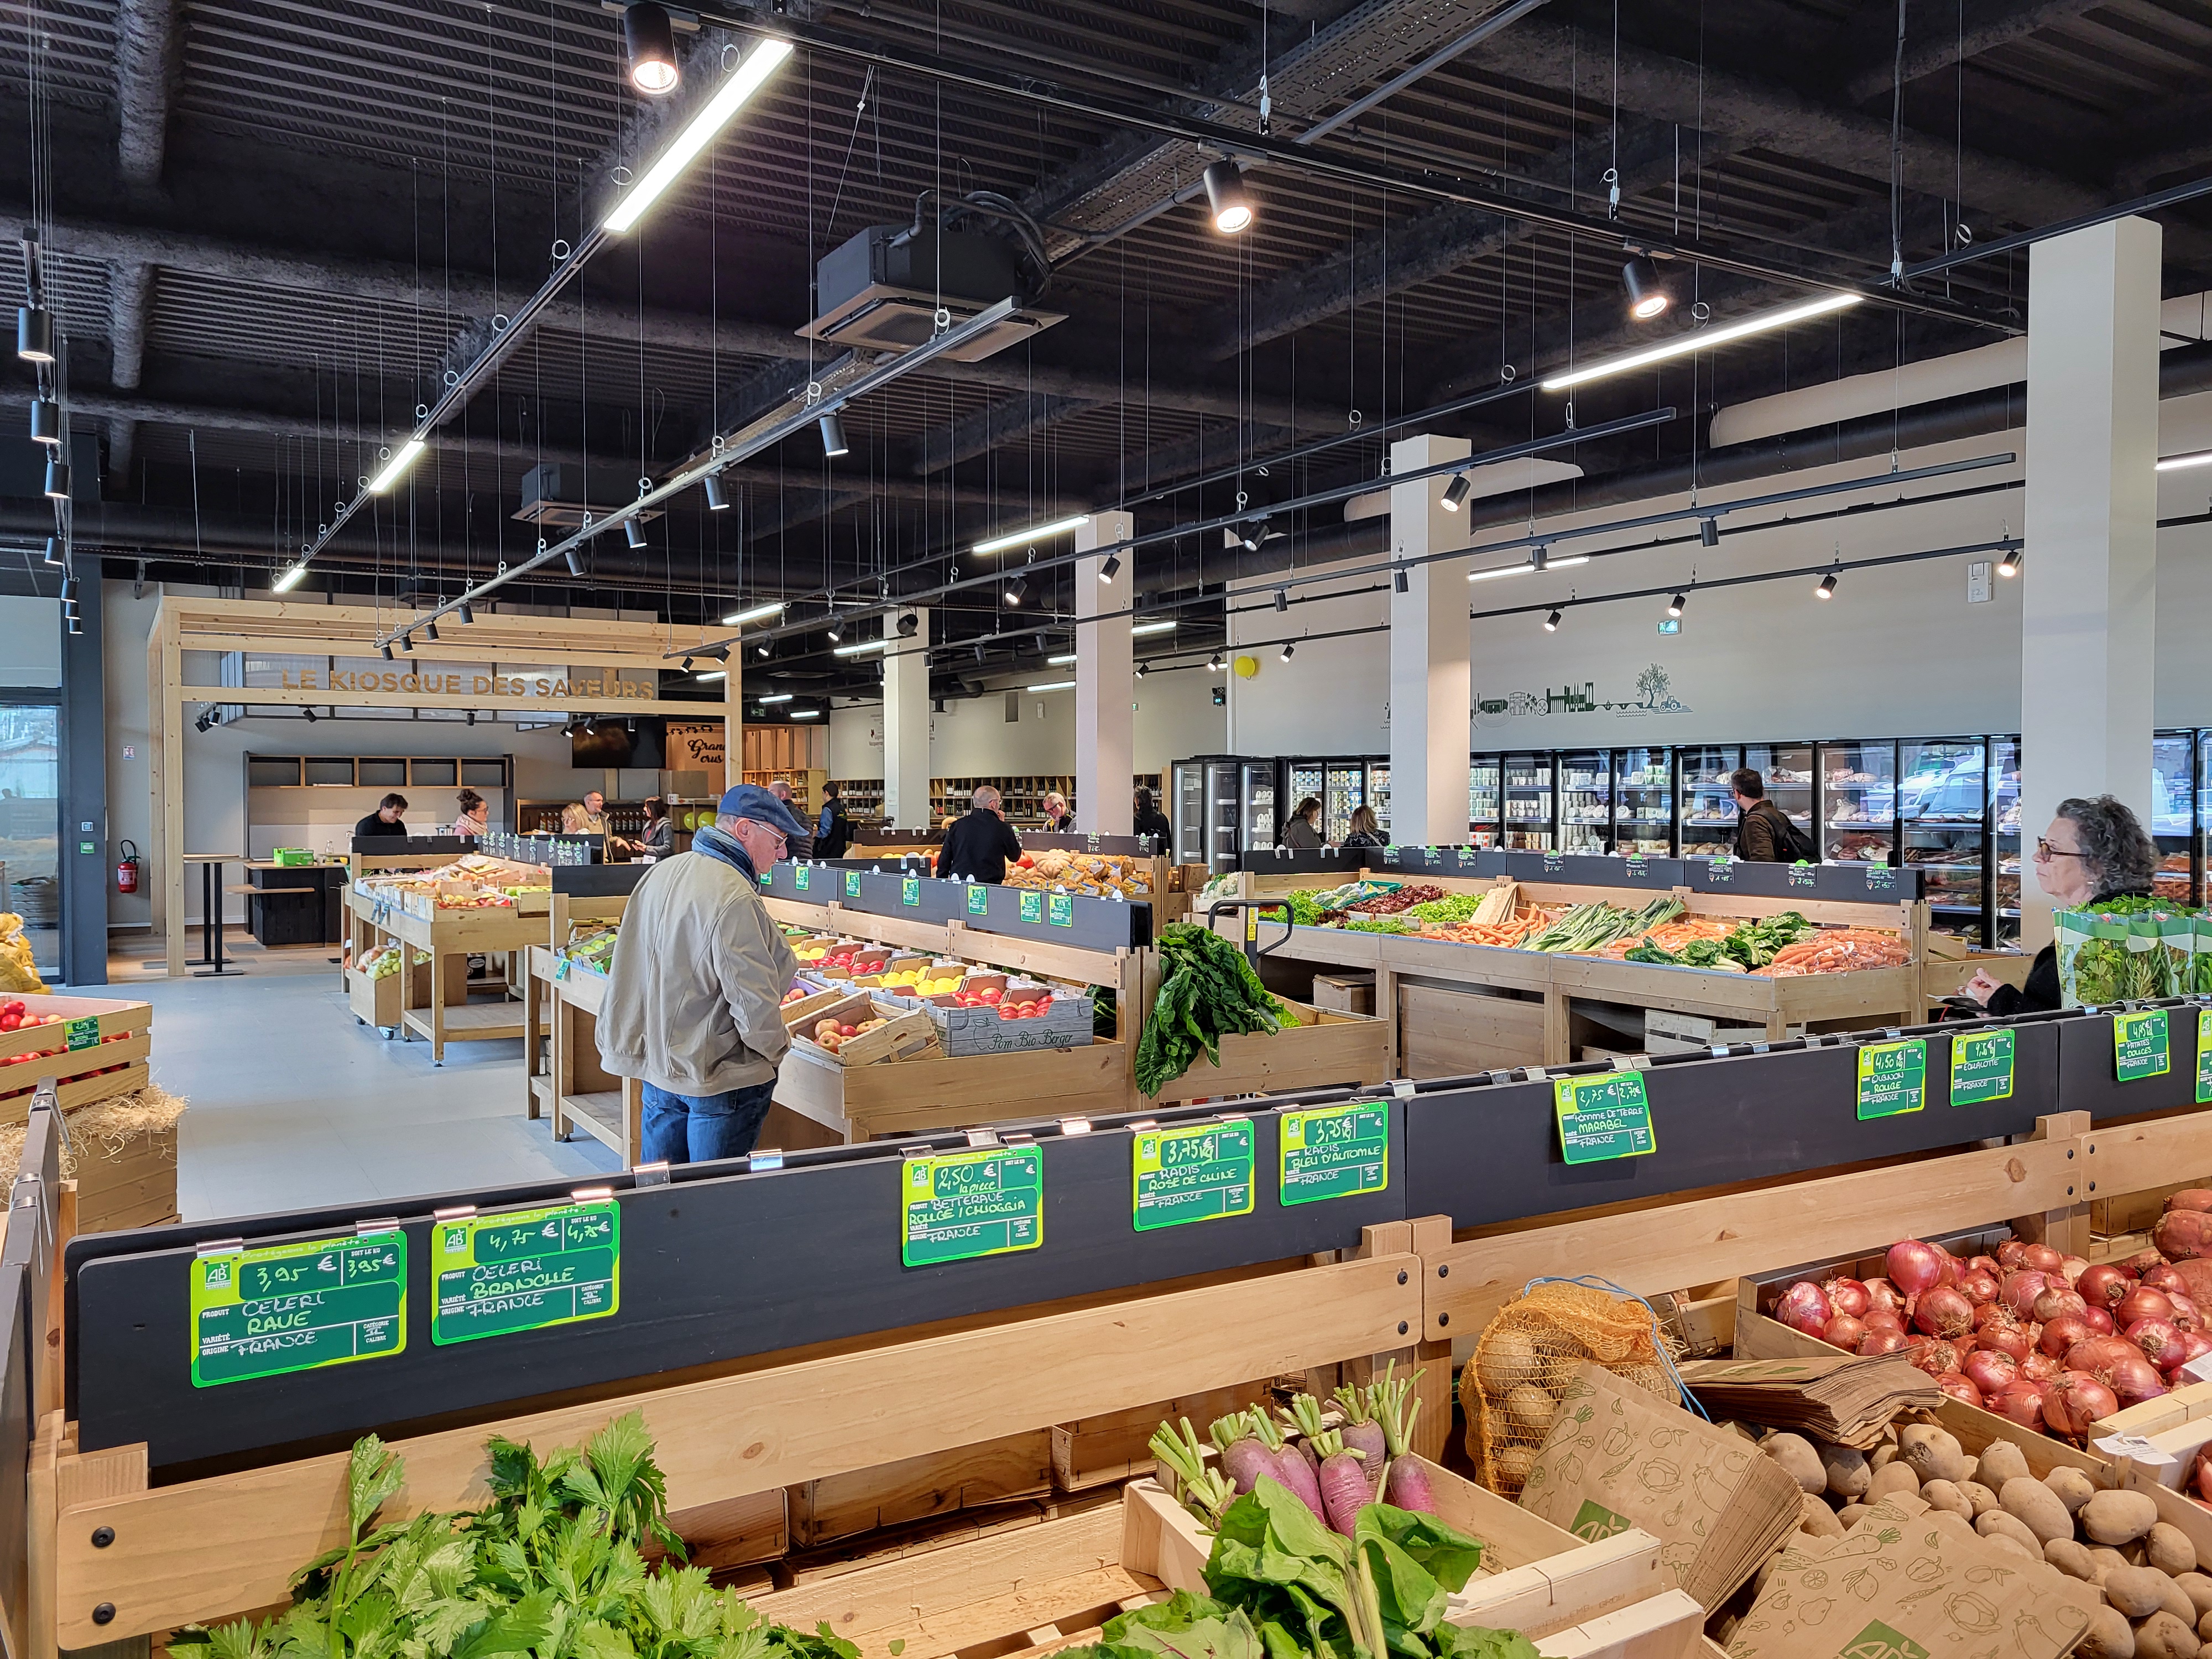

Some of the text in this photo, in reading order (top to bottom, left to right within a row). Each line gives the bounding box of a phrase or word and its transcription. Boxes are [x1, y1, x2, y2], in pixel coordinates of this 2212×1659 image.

[282, 669, 654, 700] LE KIOSQUE DES SAVEURS
[687, 739, 725, 759] Gran
[2202, 1020, 2210, 1031] AB
[988, 1029, 1073, 1050] Pom Bio Berger
[2126, 1039, 2150, 1050] PATATES
[2127, 1046, 2152, 1058] DOUCES
[1875, 1053, 1893, 1070] 4,50
[1897, 1051, 1904, 1060] €
[2126, 1058, 2148, 1068] FRANCE
[1871, 1072, 1904, 1083] OIGNON
[1562, 1088, 1570, 1097] AB
[1619, 1087, 1636, 1099] 2,75
[1874, 1082, 1901, 1094] ROUGE
[1963, 1081, 1987, 1091] FRANCE
[1580, 1085, 1616, 1107] 2,75 €
[1870, 1093, 1899, 1105] FRANCE
[1342, 1117, 1353, 1128] €
[1375, 1118, 1383, 1126] €
[1574, 1108, 1644, 1123] POMME DE TERRE
[1289, 1123, 1299, 1132] AB
[1578, 1119, 1627, 1134] MARABEL
[1239, 1137, 1248, 1146] €
[1342, 1128, 1352, 1143] kg
[1577, 1135, 1615, 1148] FRANCE
[1143, 1143, 1154, 1154] AB
[1168, 1139, 1200, 1164] 3,75
[1203, 1136, 1214, 1148] €
[1305, 1144, 1339, 1156] RADIS
[1291, 1155, 1318, 1170] BLEU
[1321, 1145, 1381, 1164] D'AUTOMNE
[914, 1169, 927, 1181] AB
[1025, 1164, 1035, 1174] €
[1160, 1165, 1200, 1180] RADIS
[938, 1164, 997, 1190] 2,50 €
[1149, 1167, 1237, 1191] ROSE DE CHINE
[1298, 1170, 1339, 1186] FRANCE
[959, 1184, 969, 1194] la
[931, 1191, 1005, 1211] BETTERAVE
[1155, 1193, 1203, 1208] FRANCE
[909, 1208, 954, 1225] ROUGE
[965, 1197, 1025, 1216] CHIOGGIA
[491, 1222, 559, 1251] 4,75 €
[567, 1221, 611, 1243] 4,75 €
[927, 1227, 981, 1243] FRANCE
[447, 1234, 464, 1246] AB
[242, 1246, 304, 1260] Protégeons
[321, 1238, 361, 1251] planète
[347, 1254, 395, 1278] 3,95 €
[207, 1267, 227, 1282] AB
[257, 1266, 309, 1292] 3,95
[317, 1255, 337, 1271] €
[441, 1271, 465, 1281] PRODUIT
[470, 1266, 576, 1299] BRANCHE
[441, 1294, 466, 1304] VARIÉTÉ
[466, 1293, 546, 1317] FRANCE
[202, 1308, 230, 1319] PRODUIT
[441, 1306, 465, 1315] ORIGINE
[247, 1310, 312, 1335] RAVE
[363, 1320, 389, 1329] CATÉGORIE
[202, 1333, 231, 1344] VARIÉTÉ
[230, 1331, 318, 1355] FRANCE
[202, 1345, 229, 1355] ORIGINE
